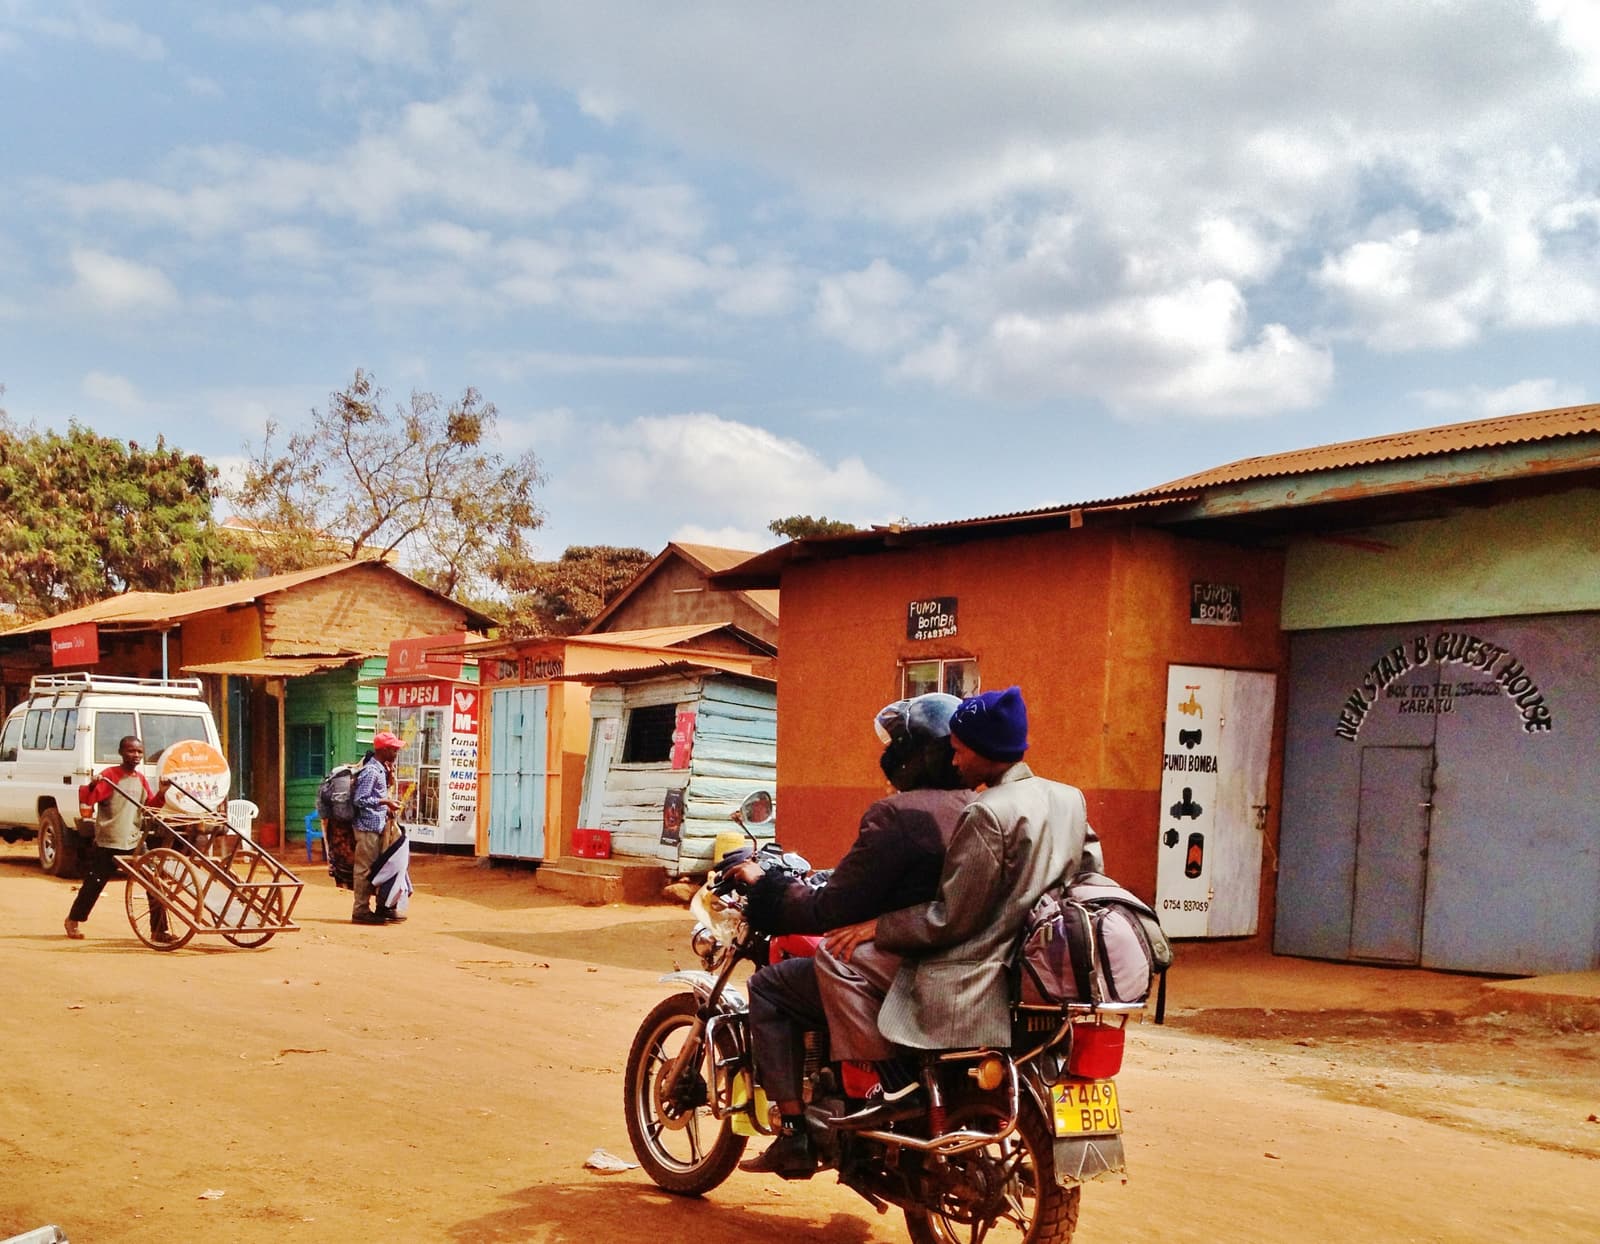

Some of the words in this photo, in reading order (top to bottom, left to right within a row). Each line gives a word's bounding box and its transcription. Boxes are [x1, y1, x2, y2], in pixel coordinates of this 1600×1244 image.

[1194, 584, 1232, 603] FUNDI
[910, 601, 941, 617] FUNDI
[1200, 603, 1240, 621] BOMBA
[398, 685, 440, 704] M-PESA
[1335, 688, 1373, 742] NEW
[1364, 645, 1415, 703] STAR
[1434, 632, 1510, 675] GUEST
[1496, 659, 1552, 734] HOUSE
[1164, 754, 1187, 771] FUNDI
[1188, 755, 1218, 774] BOMBA
[1163, 899, 1181, 910] 0754
[1081, 1109, 1118, 1131] BPU
